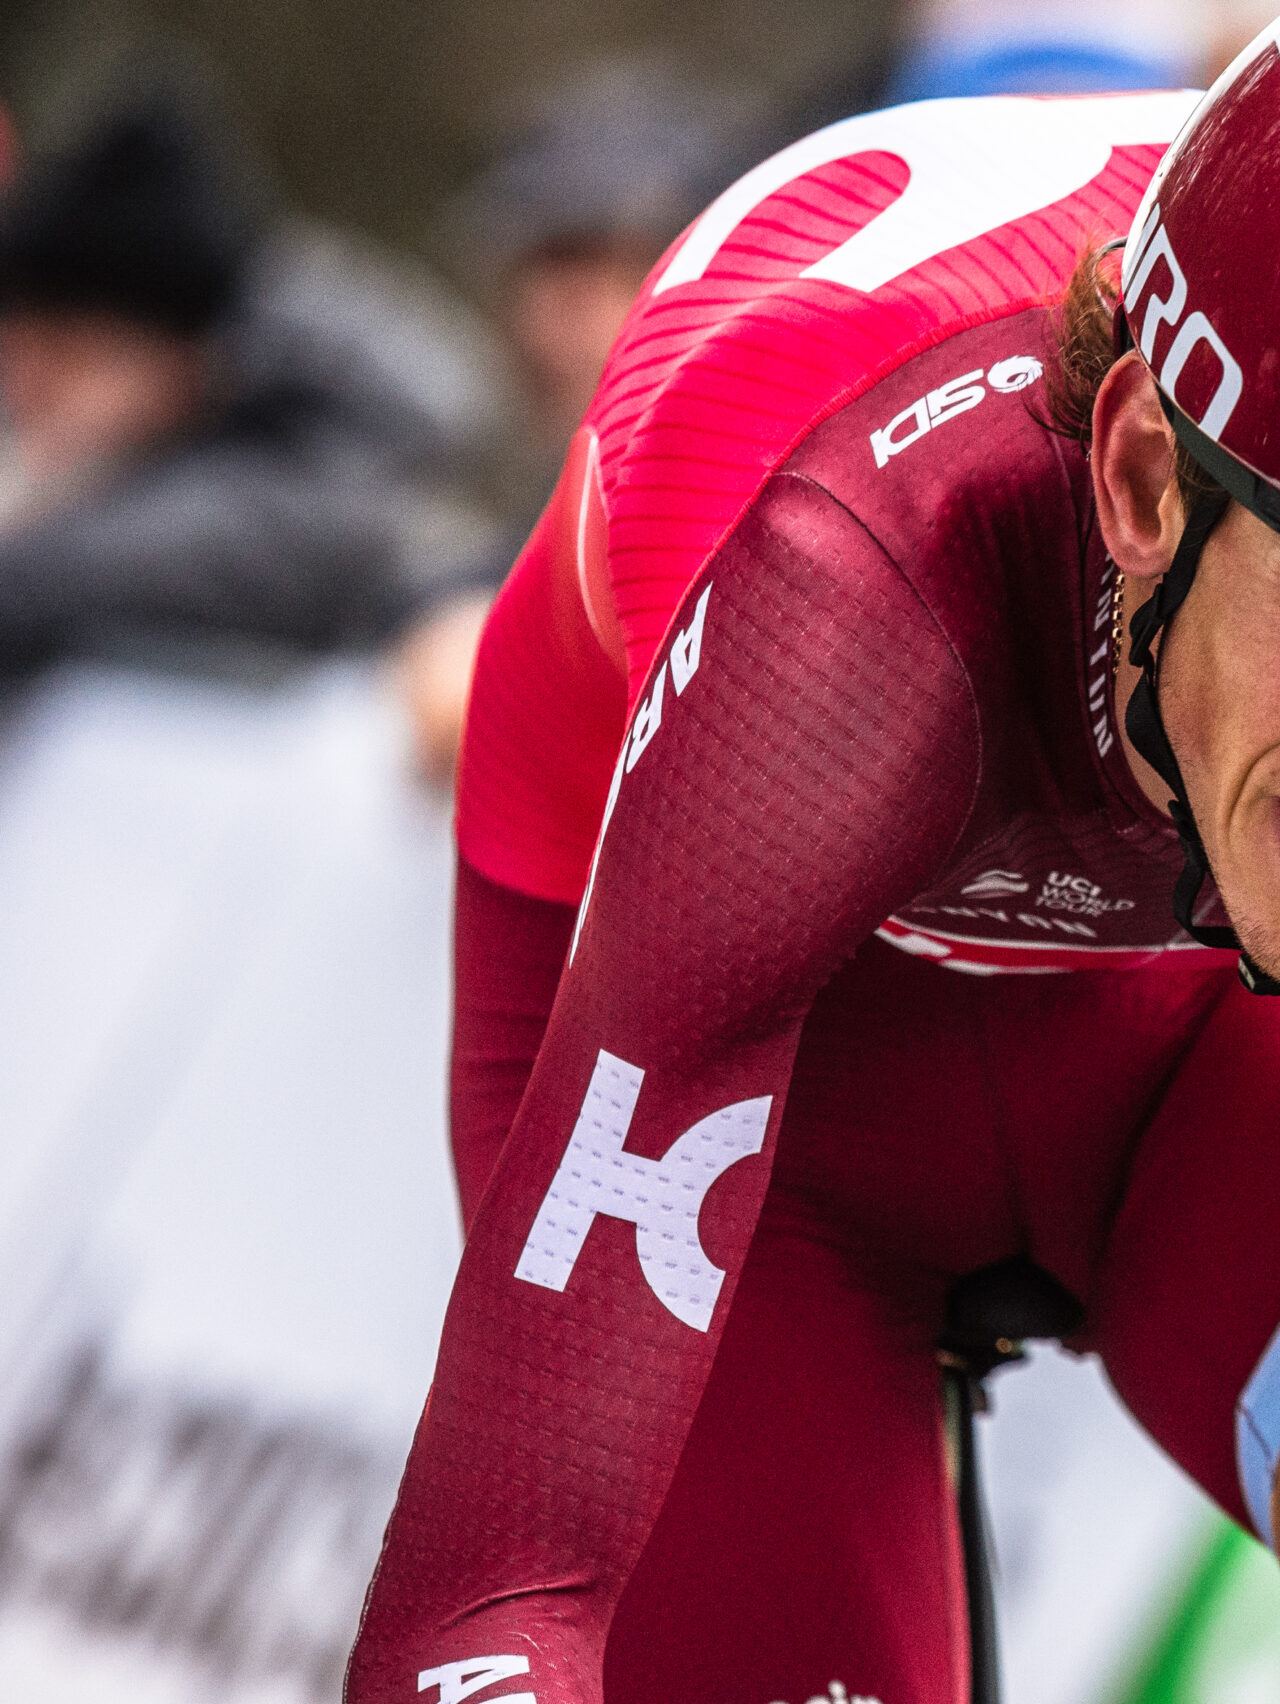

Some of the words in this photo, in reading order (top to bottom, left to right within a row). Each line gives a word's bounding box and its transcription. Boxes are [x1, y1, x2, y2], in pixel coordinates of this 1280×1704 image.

[1121, 202, 1244, 442] IRO
[1047, 870, 1102, 897] UCI
[1036, 897, 1103, 917] TOUR
[1042, 884, 1136, 912] WORLD
